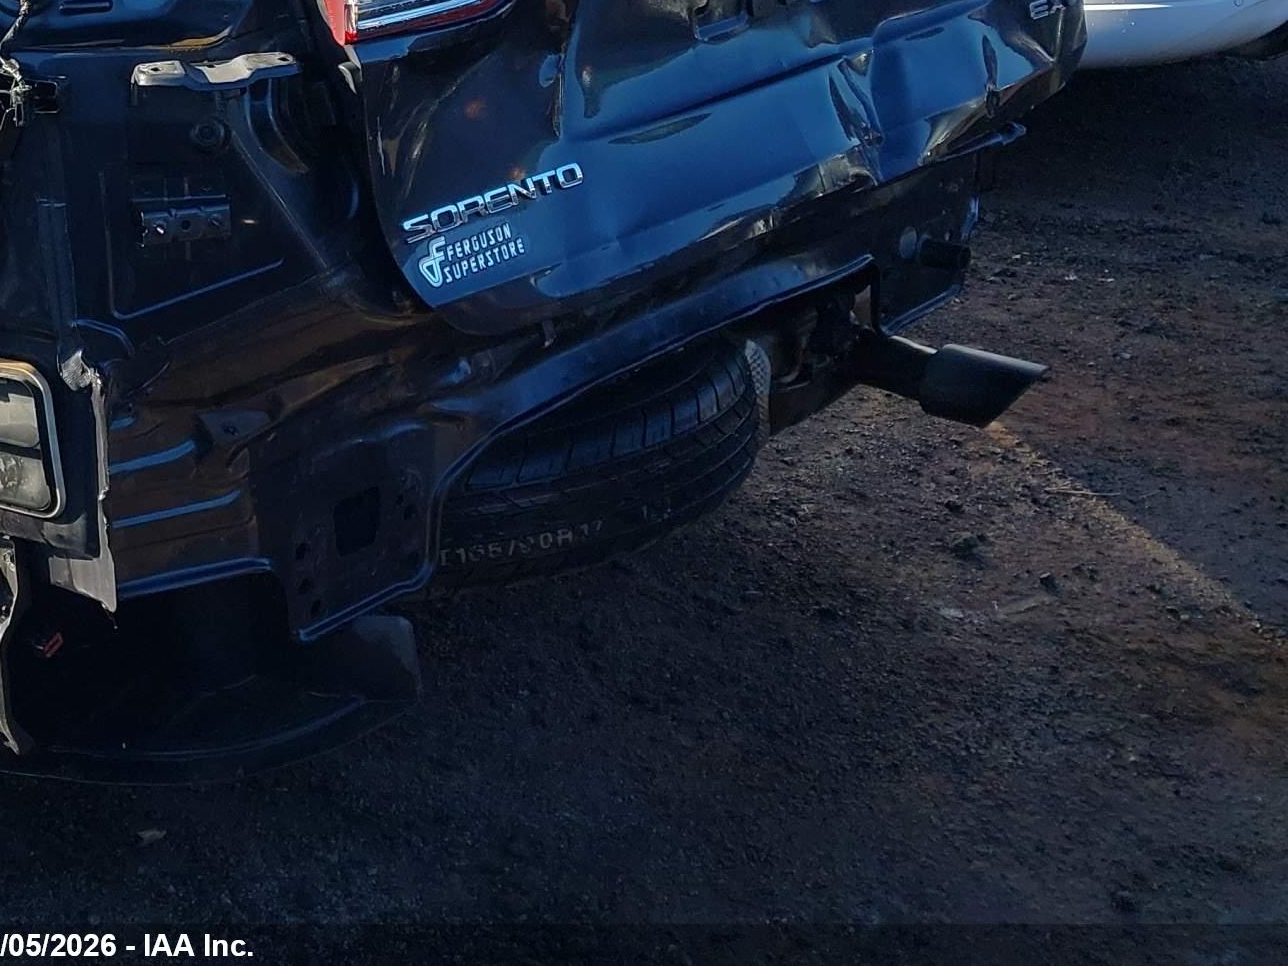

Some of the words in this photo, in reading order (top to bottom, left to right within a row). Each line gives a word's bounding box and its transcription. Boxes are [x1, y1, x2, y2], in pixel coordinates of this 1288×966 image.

[402, 162, 584, 244] SORENTO
[443, 237, 525, 284] SUPERSTORE
[446, 222, 513, 262] FERGUSON
